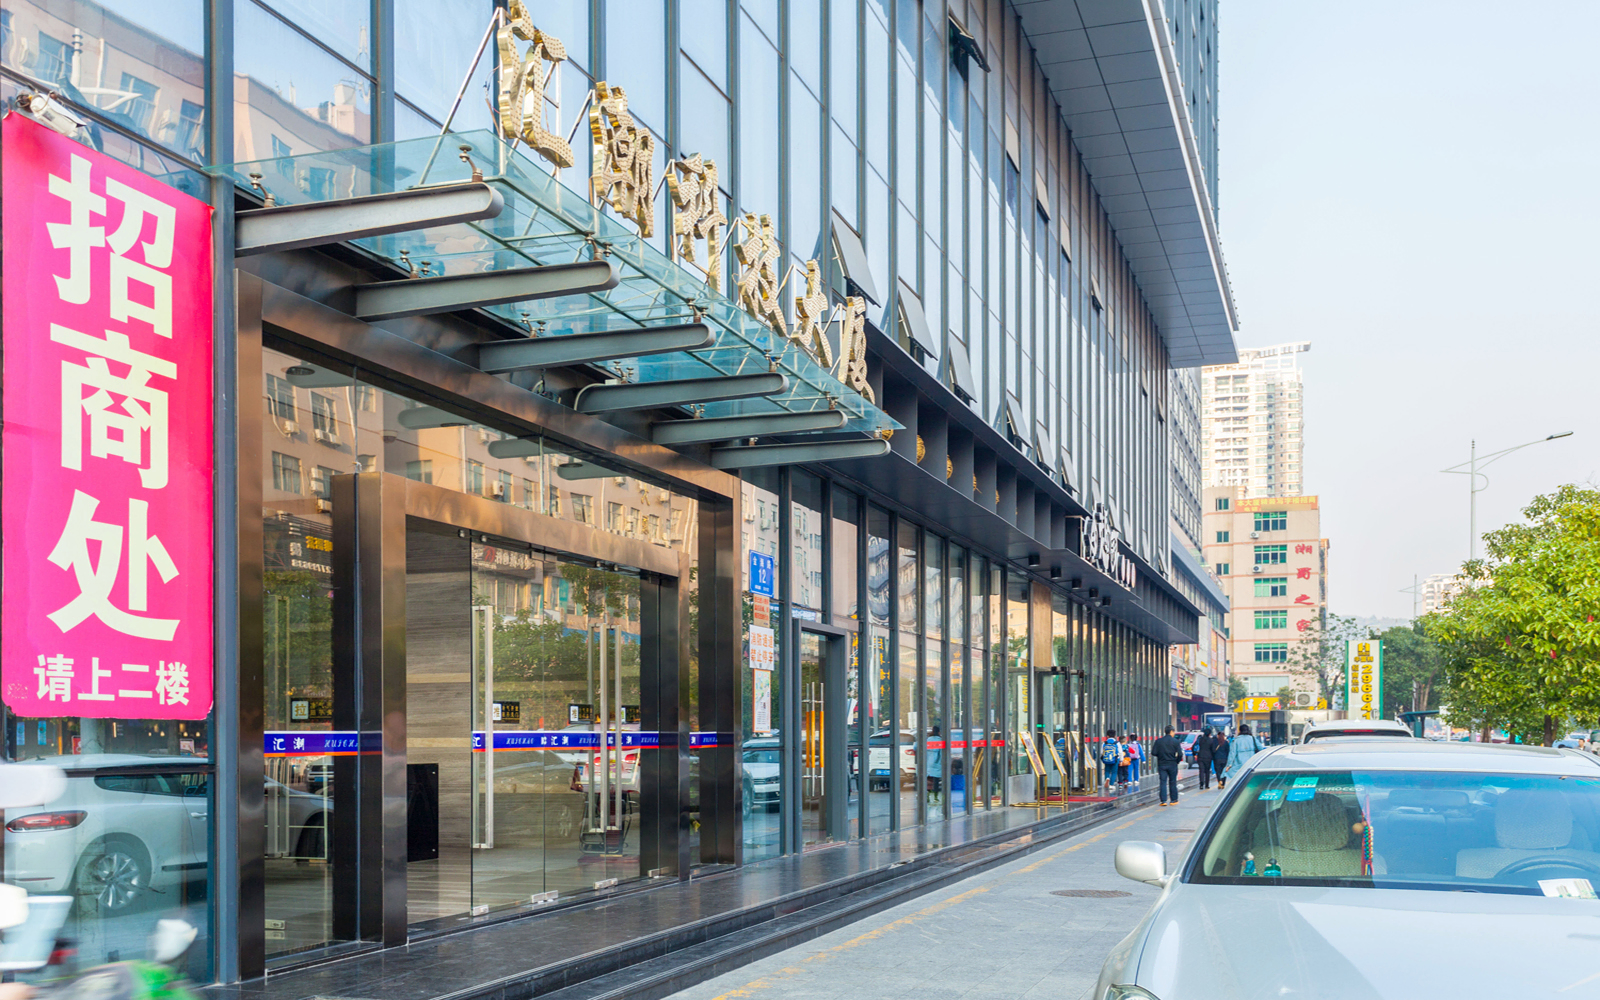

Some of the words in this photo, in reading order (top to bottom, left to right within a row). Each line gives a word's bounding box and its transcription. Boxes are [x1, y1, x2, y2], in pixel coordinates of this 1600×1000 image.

[46, 154, 181, 642] 招商处
[758, 568, 766, 583] 12
[33, 653, 191, 705] 请上二楼
[294, 704, 307, 717] 拉
